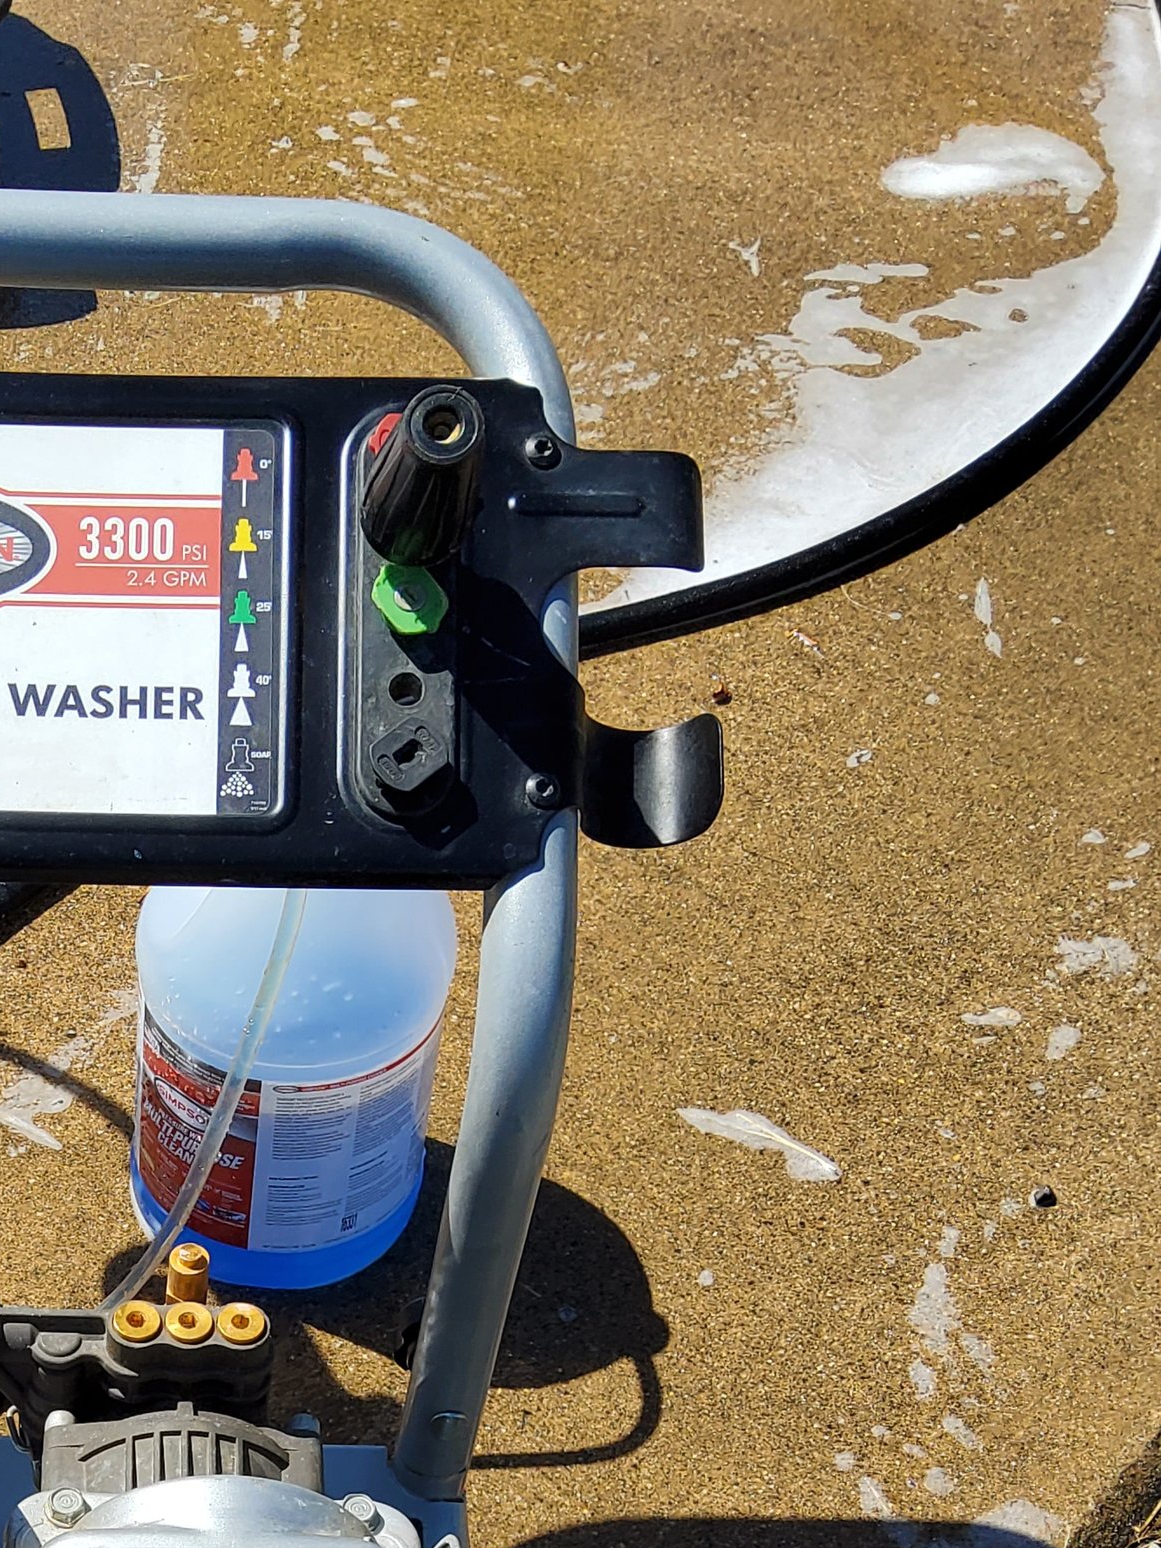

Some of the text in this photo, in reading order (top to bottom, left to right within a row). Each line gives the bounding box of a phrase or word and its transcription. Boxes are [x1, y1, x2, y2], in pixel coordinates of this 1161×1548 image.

[78, 516, 208, 562] 3300 PSI
[127, 569, 208, 588] 2.4 GPM
[8, 682, 206, 721] WASHER
[157, 1084, 209, 1125] SIMPSO
